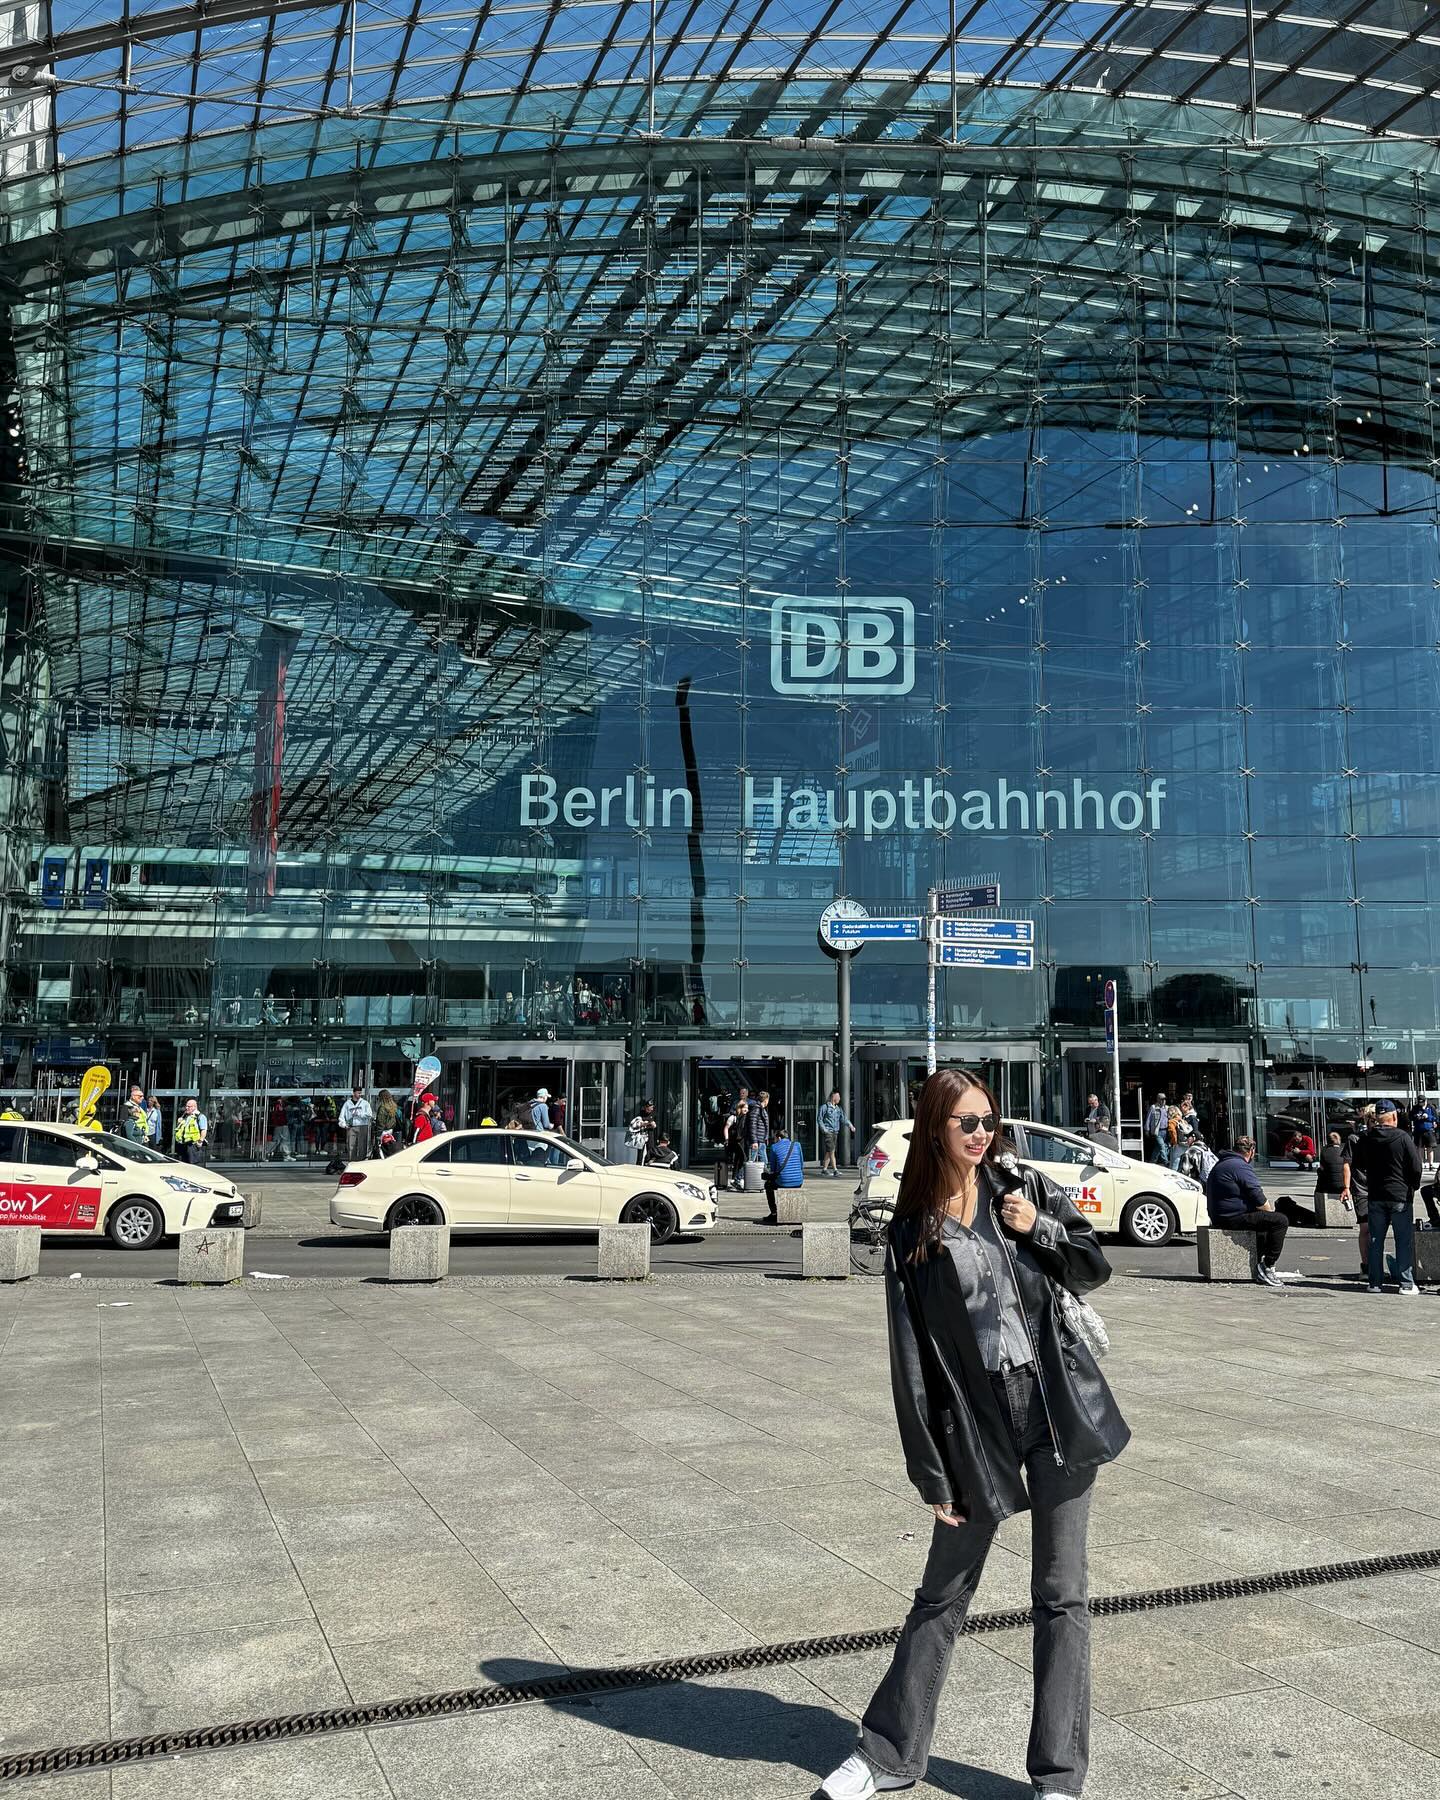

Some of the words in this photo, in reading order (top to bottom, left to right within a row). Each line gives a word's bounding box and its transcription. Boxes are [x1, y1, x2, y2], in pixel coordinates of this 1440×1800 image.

[790, 612, 897, 678] DB
[520, 774, 693, 828] Berlin
[743, 776, 1167, 841] Hauptbahnhof
[1082, 1187, 1096, 1200] K
[20, 1213, 47, 1221] Mobilität
